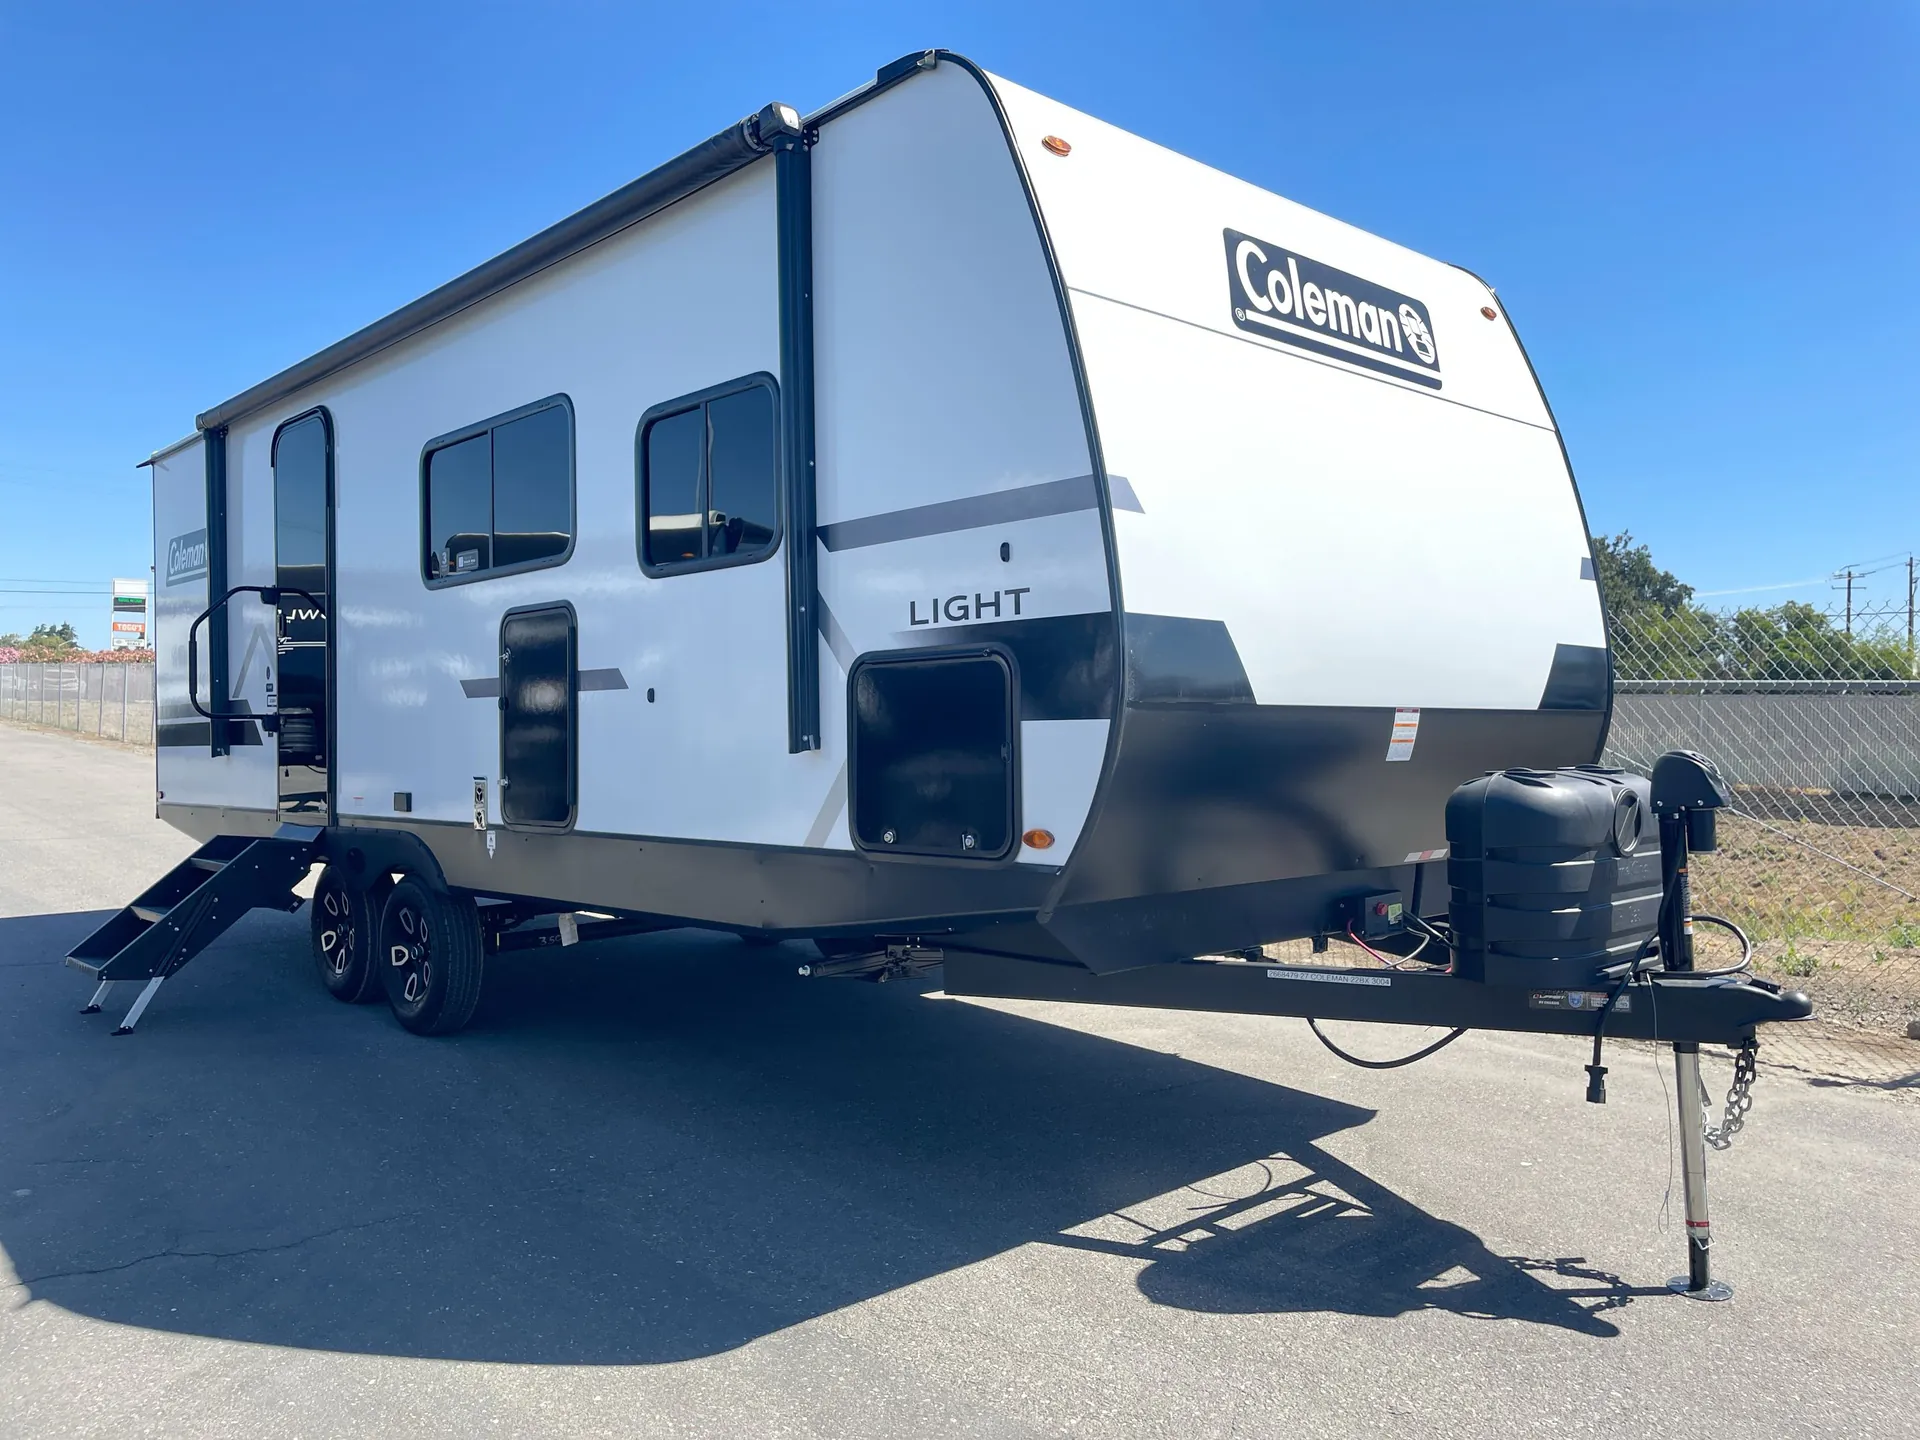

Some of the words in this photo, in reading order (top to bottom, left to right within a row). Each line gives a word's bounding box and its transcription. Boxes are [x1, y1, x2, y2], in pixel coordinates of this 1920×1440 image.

[1235, 239, 1403, 353] Coleman
[169, 540, 204, 575] Coleman
[909, 587, 1031, 626] LIGHT
[1299, 972, 1309, 980] 27
[1310, 974, 1349, 982] COLEMAN
[1371, 977, 1390, 985] 3004
